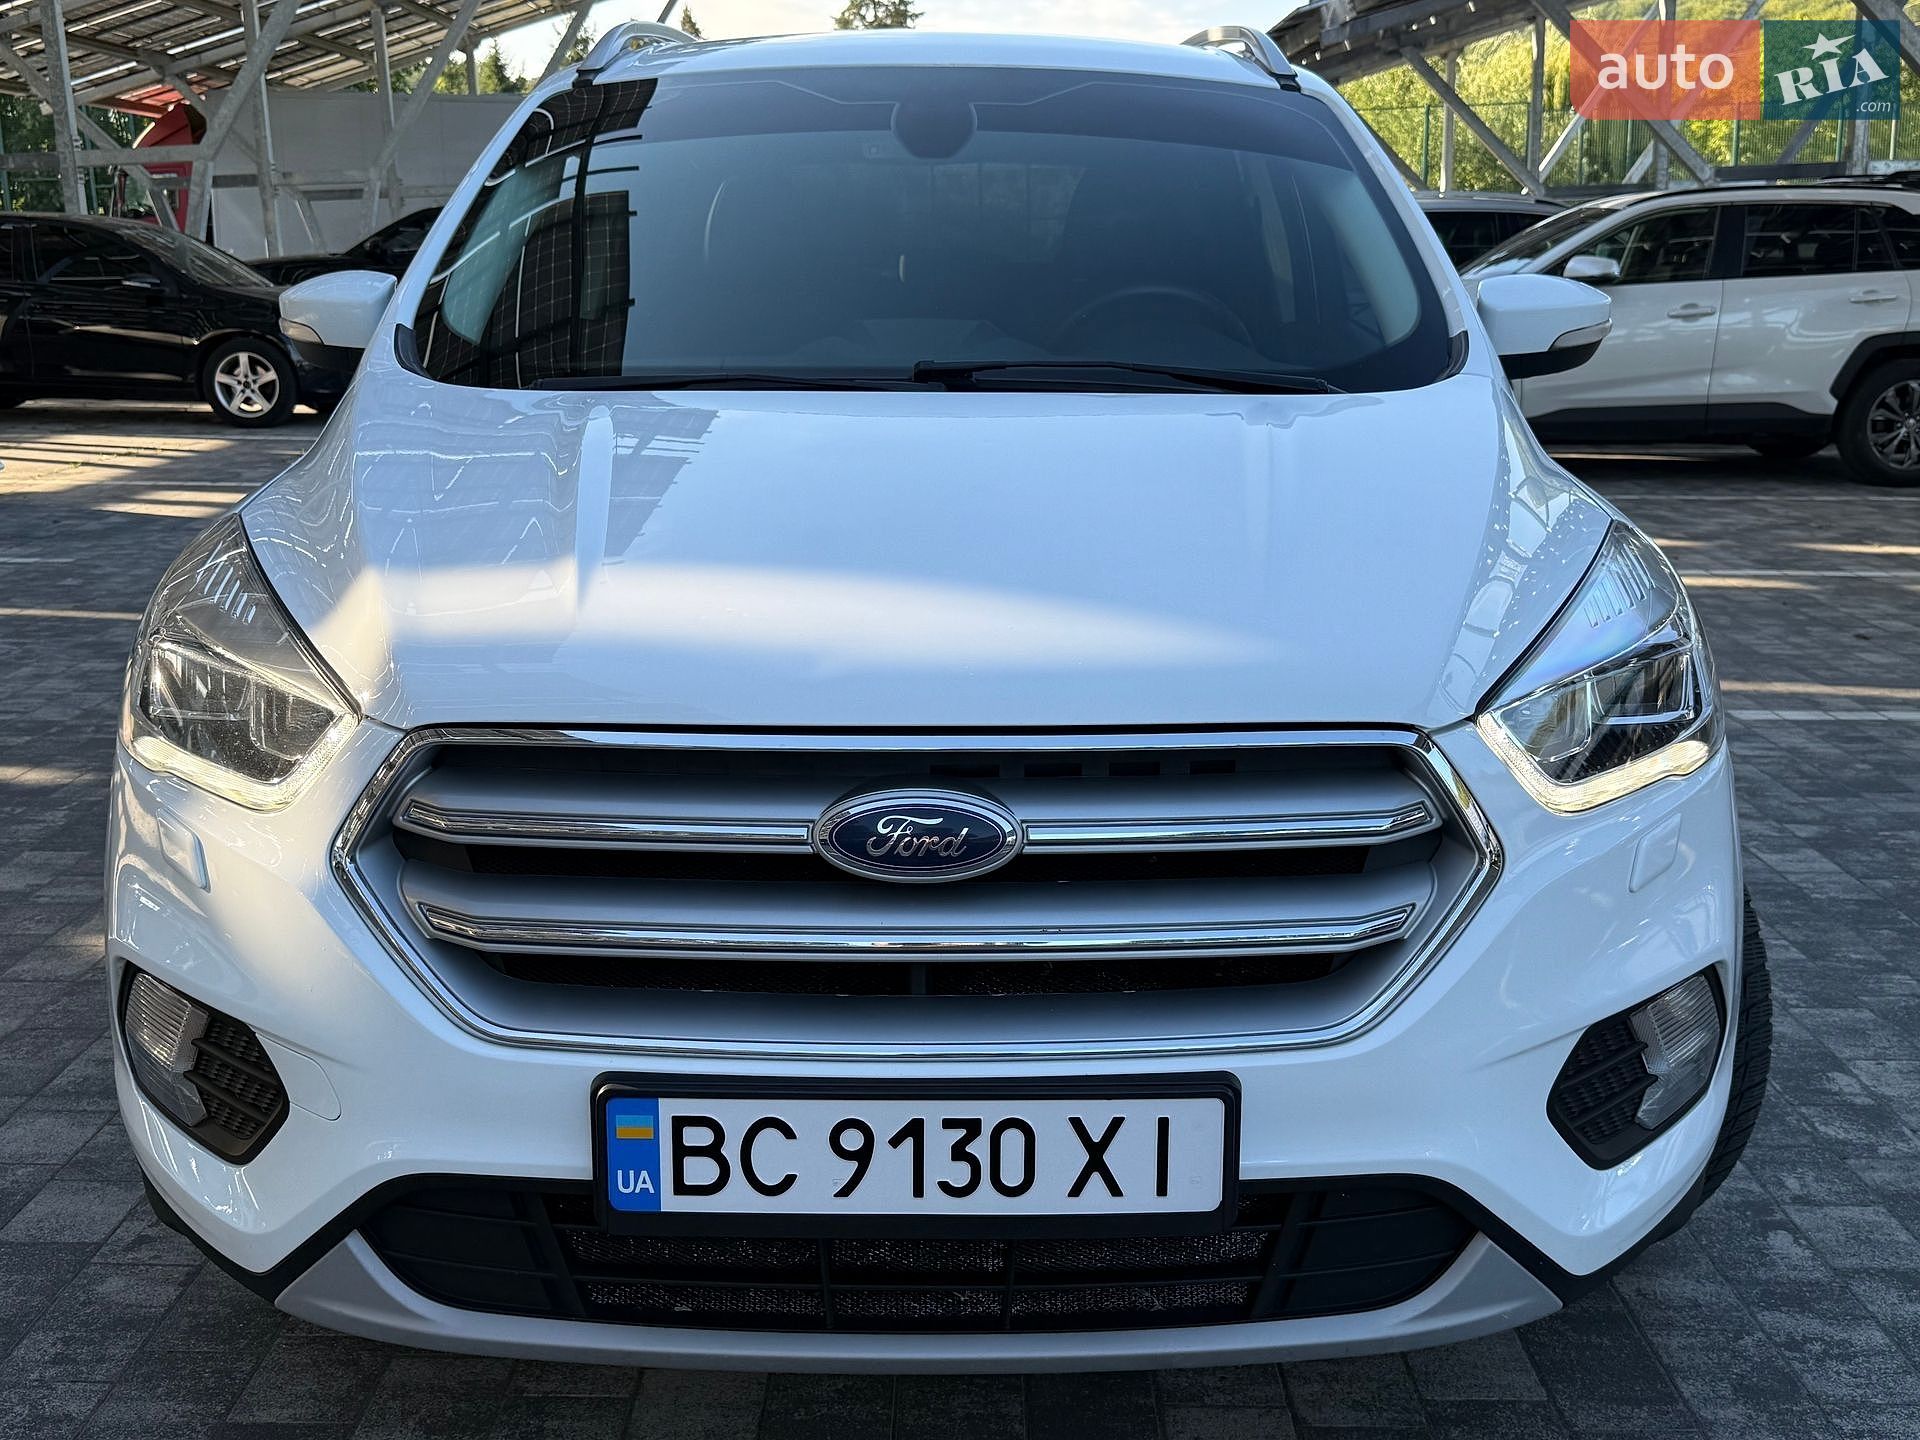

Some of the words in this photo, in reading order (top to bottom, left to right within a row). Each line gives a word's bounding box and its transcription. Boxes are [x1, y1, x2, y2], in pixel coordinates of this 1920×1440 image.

[866, 815, 969, 857] Ford
[671, 1115, 799, 1198] BC
[828, 1116, 1036, 1199] 9130
[616, 1170, 655, 1194] UA
